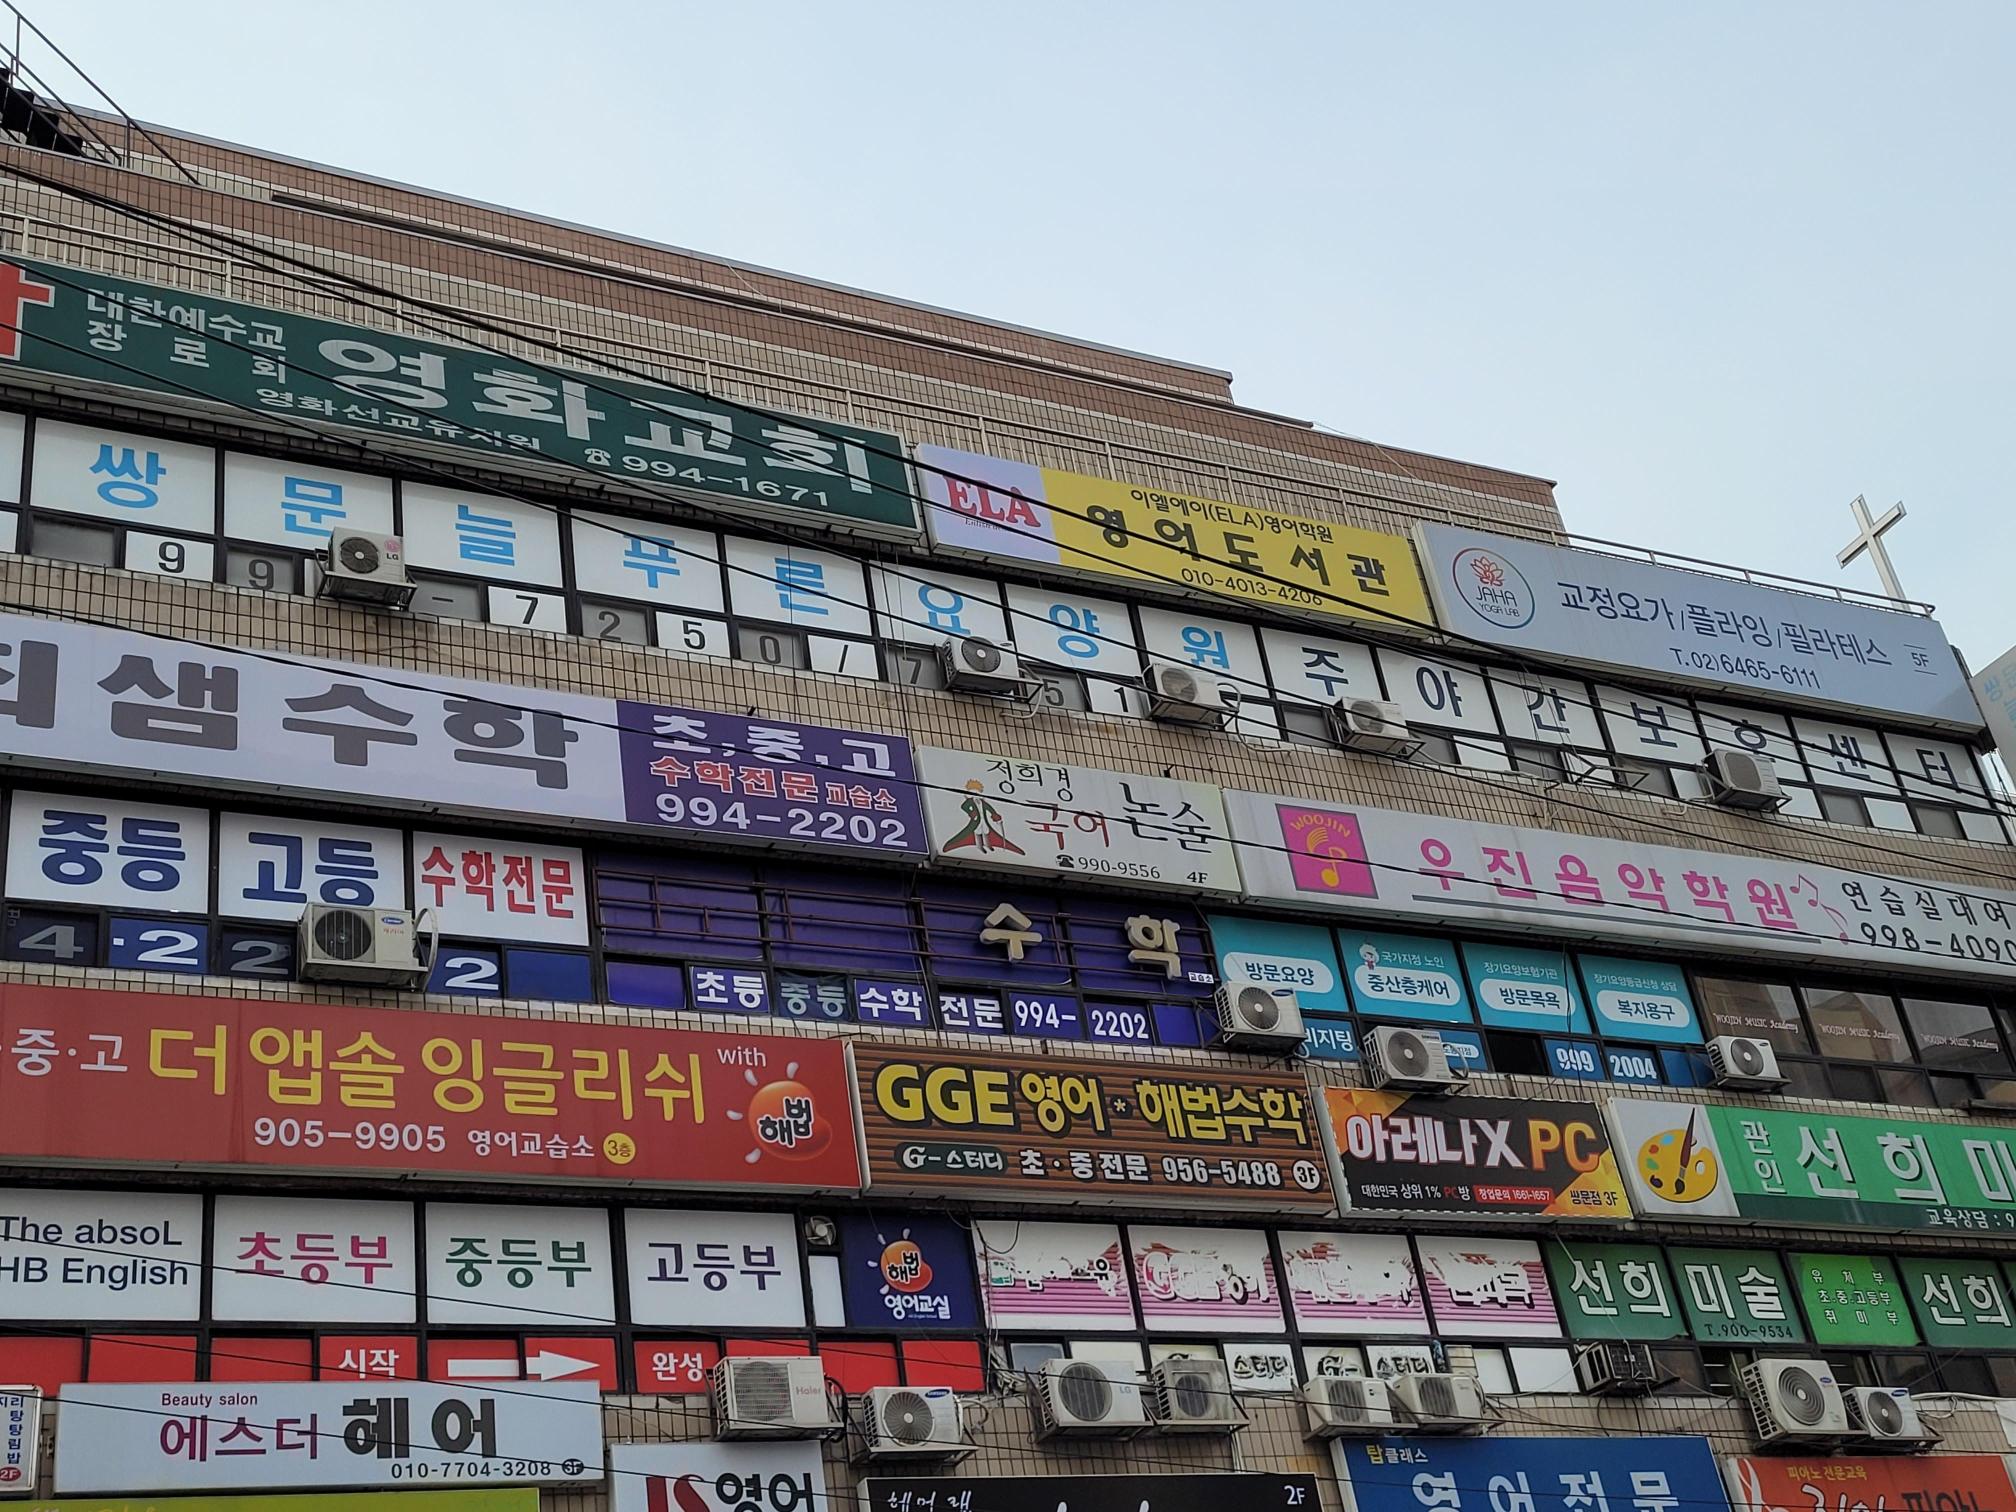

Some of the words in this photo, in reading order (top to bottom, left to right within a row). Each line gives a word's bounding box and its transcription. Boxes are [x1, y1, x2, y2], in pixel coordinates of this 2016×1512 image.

[87, 288, 287, 352] 대한예수교
[318, 339, 873, 494] 영화교회
[622, 455, 830, 507] 994-1671
[943, 472, 1042, 529] ELA
[1130, 488, 1334, 546] 이엘에이(ELA)영어학원
[1085, 503, 1390, 597] 영어도서관
[1180, 566, 1324, 607] 010-4013-4206
[1475, 586, 1518, 608] JAHA
[1478, 602, 1504, 615] YOGA
[1504, 606, 1520, 618] LAB
[1910, 651, 1930, 670] 5F
[649, 756, 819, 804] 수학전문
[824, 781, 898, 813] 교습소
[985, 759, 1073, 802] 정희경
[655, 793, 908, 849] 994-2202
[1025, 799, 1110, 851] 국어
[1290, 814, 1351, 838] WOOJIN
[38, 809, 186, 892] 중등
[242, 831, 380, 906] 고등
[421, 846, 574, 920] 수학전문
[1078, 855, 1161, 880] 990-9556
[1186, 871, 1208, 884] 4F
[1418, 837, 1800, 931] 우진음악학원
[1382, 950, 1422, 965] 국가지정
[1423, 955, 1445, 969] 노인
[1860, 921, 2016, 963] 998-4090
[696, 971, 766, 1008] 초등
[1245, 961, 1315, 987] 방문요양
[1367, 973, 1451, 999] 중산층케어
[780, 978, 848, 1018] 중등
[858, 986, 922, 1024] 수학
[941, 995, 1004, 1032] 전문
[1499, 986, 1561, 1010] 방문목욕
[1616, 998, 1677, 1022] 복지용구
[1745, 1017, 1768, 1029] MUSIC
[1849, 1028, 1872, 1039] MUSIC
[717, 1046, 767, 1068] with
[1948, 1037, 1971, 1048] MUSIC
[1609, 1054, 1658, 1080] 2004
[757, 1095, 815, 1149] 해법
[875, 1063, 1014, 1127] GGE
[1019, 1070, 1107, 1136] 영어
[1134, 1079, 1307, 1147] 해법수학
[253, 1116, 446, 1153] 905-9905
[467, 1128, 595, 1160] 영어교습소
[607, 1138, 632, 1159] 3층
[1527, 1118, 1600, 1173] PC
[1161, 1155, 1282, 1186] 956-5488
[1296, 1165, 1318, 1184] 3F
[1361, 1184, 1398, 1199] 대한민국
[1400, 1183, 1422, 1200] 상위
[1424, 1185, 1441, 1199] 1%
[1569, 1189, 1603, 1206] 쌍문점
[1604, 1191, 1619, 1208] 3F
[1, 1216, 64, 1245] The
[74, 1219, 183, 1247] absoL
[62, 1257, 189, 1292] English
[235, 1231, 393, 1286] 초등부
[445, 1236, 592, 1289] 중등부
[647, 1242, 782, 1292] 고등부
[886, 1250, 921, 1284] 해법
[884, 1294, 951, 1320] 영어교실
[1568, 1259, 1673, 1319] 선희
[1683, 1261, 1787, 1321] 미술
[1922, 1272, 2013, 1327] 선희
[338, 1348, 400, 1379] 시작
[651, 1352, 704, 1383] 완성
[161, 1392, 214, 1408] Beauty
[219, 1392, 258, 1406] salon
[160, 1413, 319, 1462] 에스더
[342, 1397, 497, 1460] 헤어
[391, 1460, 552, 1479] 010-7704-3208
[1786, 1465, 1822, 1481] 피아노
[1283, 1485, 1306, 1505] 2F
